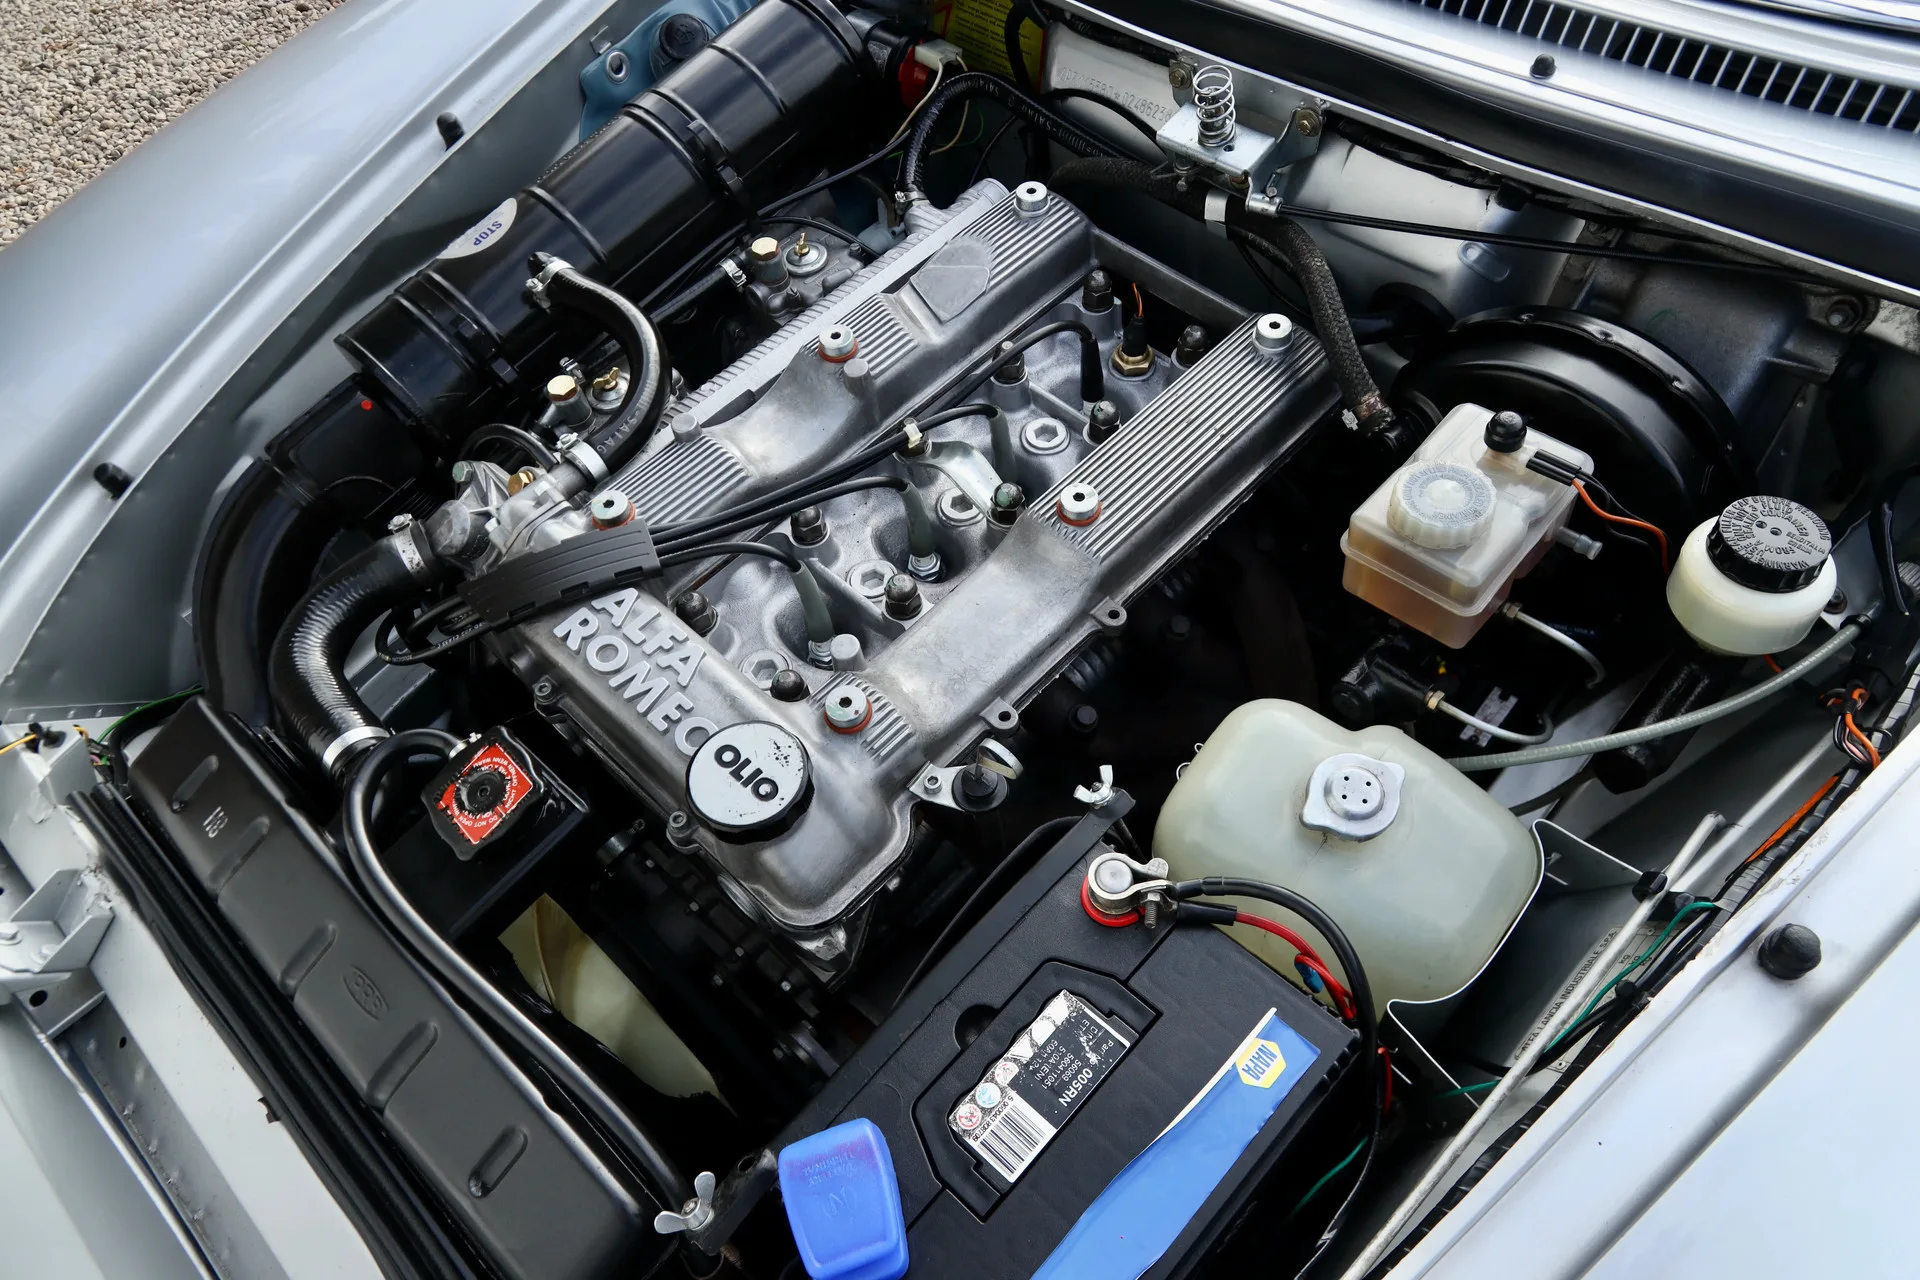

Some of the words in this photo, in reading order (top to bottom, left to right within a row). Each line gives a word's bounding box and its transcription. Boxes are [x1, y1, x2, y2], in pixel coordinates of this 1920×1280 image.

[473, 220, 503, 246] STOP
[596, 415, 637, 454] SAIAG
[1721, 509, 1737, 533] FILLER
[1732, 497, 1750, 511] CAP
[1751, 496, 1793, 506] BEFORE
[1761, 501, 1793, 514] FLUID
[591, 587, 706, 687] ALFA
[553, 607, 718, 756] ROMEO
[714, 744, 779, 802] OLIO
[1560, 951, 1601, 1002] INDUSTRIALE
[1618, 954, 1631, 965] kg
[1100, 1038, 1114, 1056] Part
[1242, 1044, 1278, 1081] NAPA
[1058, 1067, 1094, 1107] 005RN
